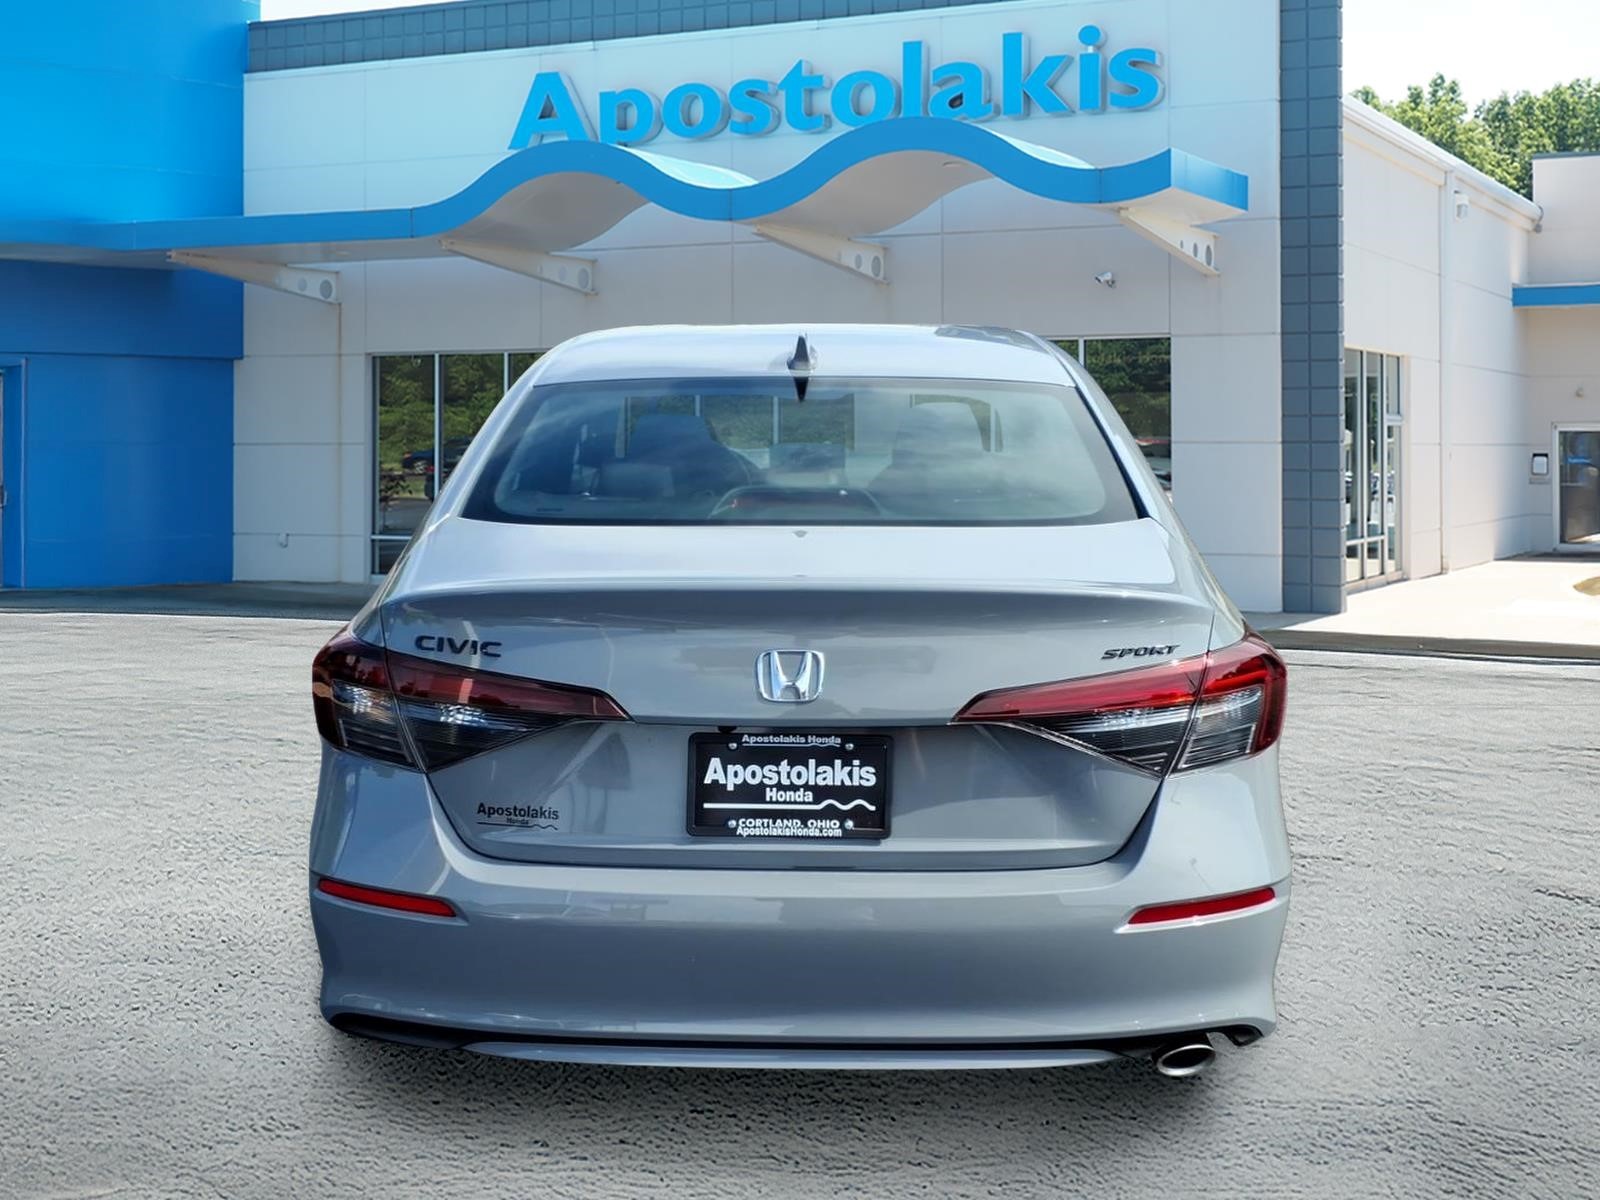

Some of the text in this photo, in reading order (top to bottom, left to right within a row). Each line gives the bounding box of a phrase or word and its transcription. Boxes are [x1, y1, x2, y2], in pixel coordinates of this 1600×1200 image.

[508, 24, 1164, 149] Apostolakis
[414, 635, 502, 657] CIVIC
[1101, 645, 1180, 660] SPORT
[741, 734, 841, 744] Apostolakis Honda
[703, 757, 877, 791] Apostolakis
[765, 787, 813, 802] Honda
[477, 802, 559, 820] Apostolakis
[736, 826, 842, 837] ApostolakisHonda.com
[807, 819, 840, 829] OHIO
